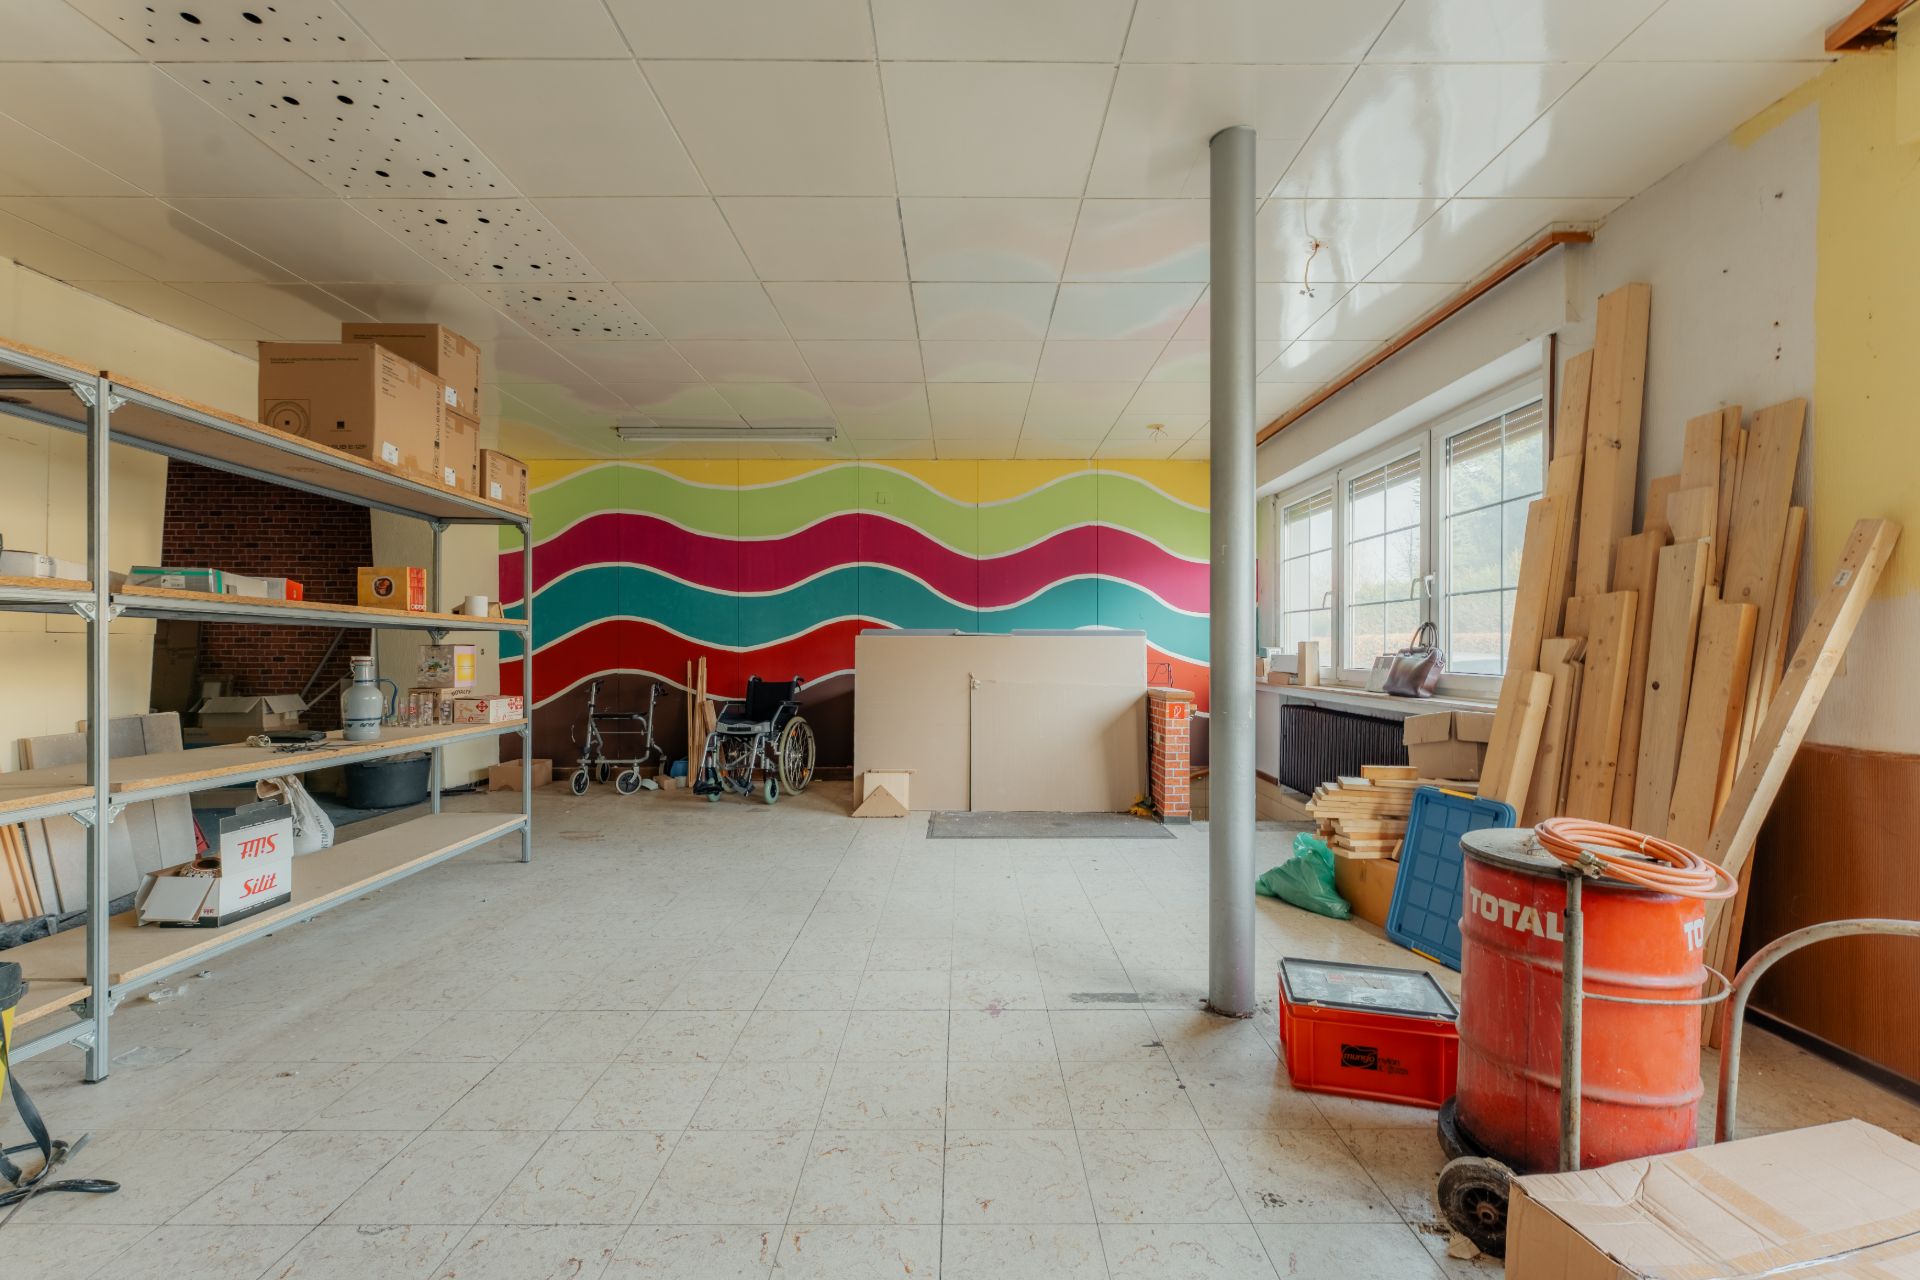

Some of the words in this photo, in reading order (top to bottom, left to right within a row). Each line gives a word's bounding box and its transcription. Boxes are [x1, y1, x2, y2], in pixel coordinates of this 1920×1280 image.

[237, 833, 279, 861] Silit
[239, 872, 278, 899] Silit
[1469, 886, 1564, 942] TOTAL
[1343, 1052, 1376, 1064] mungo
